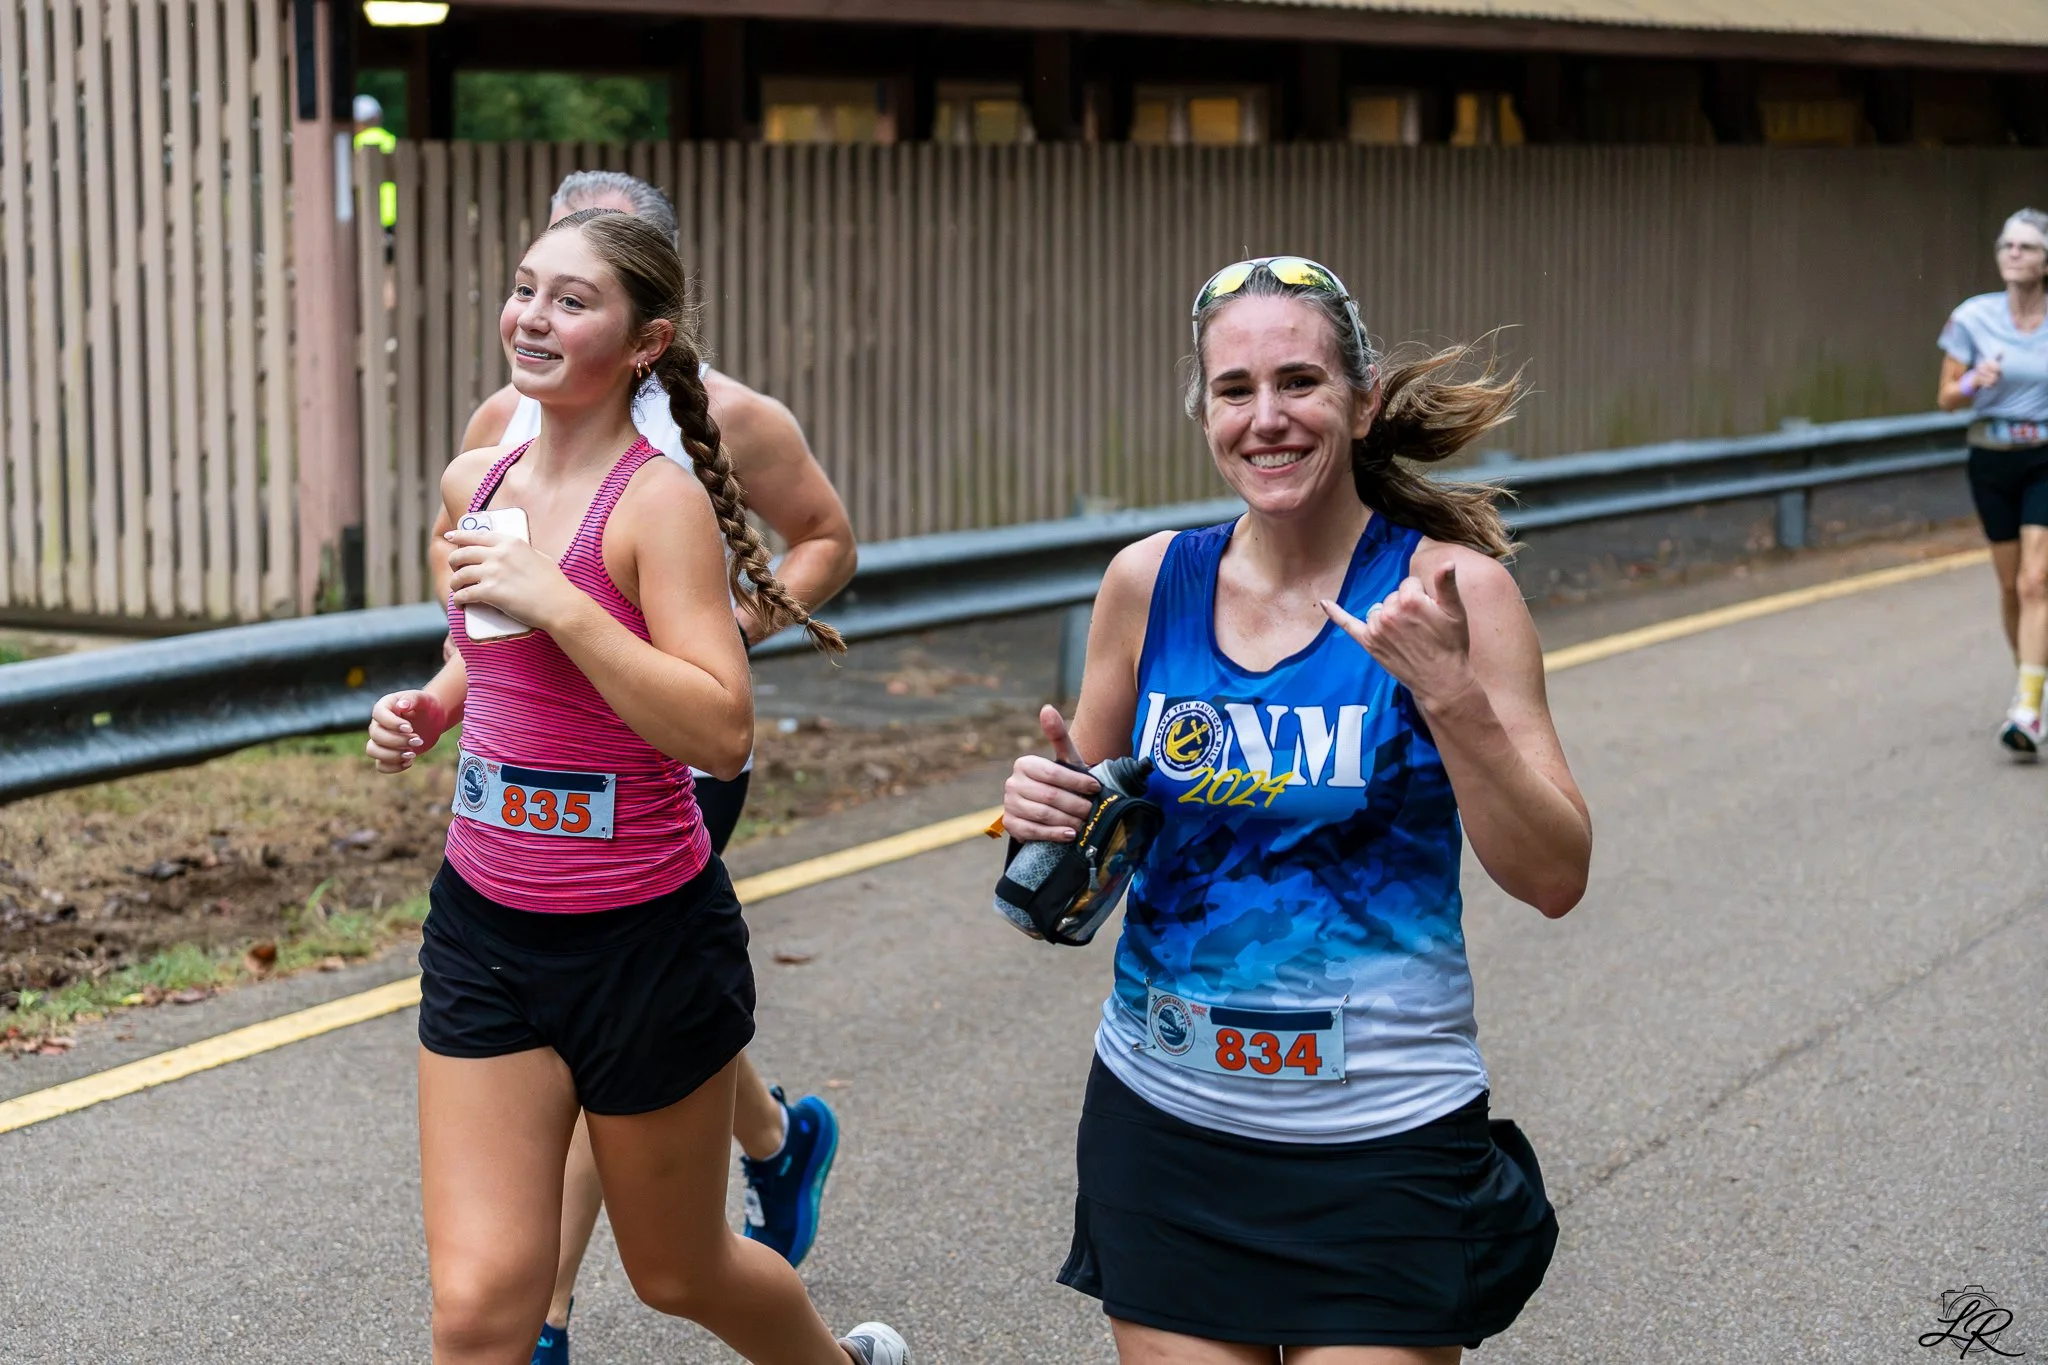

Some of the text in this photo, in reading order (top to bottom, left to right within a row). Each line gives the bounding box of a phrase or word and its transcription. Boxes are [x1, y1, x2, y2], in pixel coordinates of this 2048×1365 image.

[1156, 712, 1171, 739] NAVY
[1173, 703, 1191, 713] TEN
[1194, 702, 1222, 736] NAUTICAL
[501, 784, 592, 834] 835
[1178, 768, 1295, 808] 2024
[1215, 1027, 1323, 1076] 834
